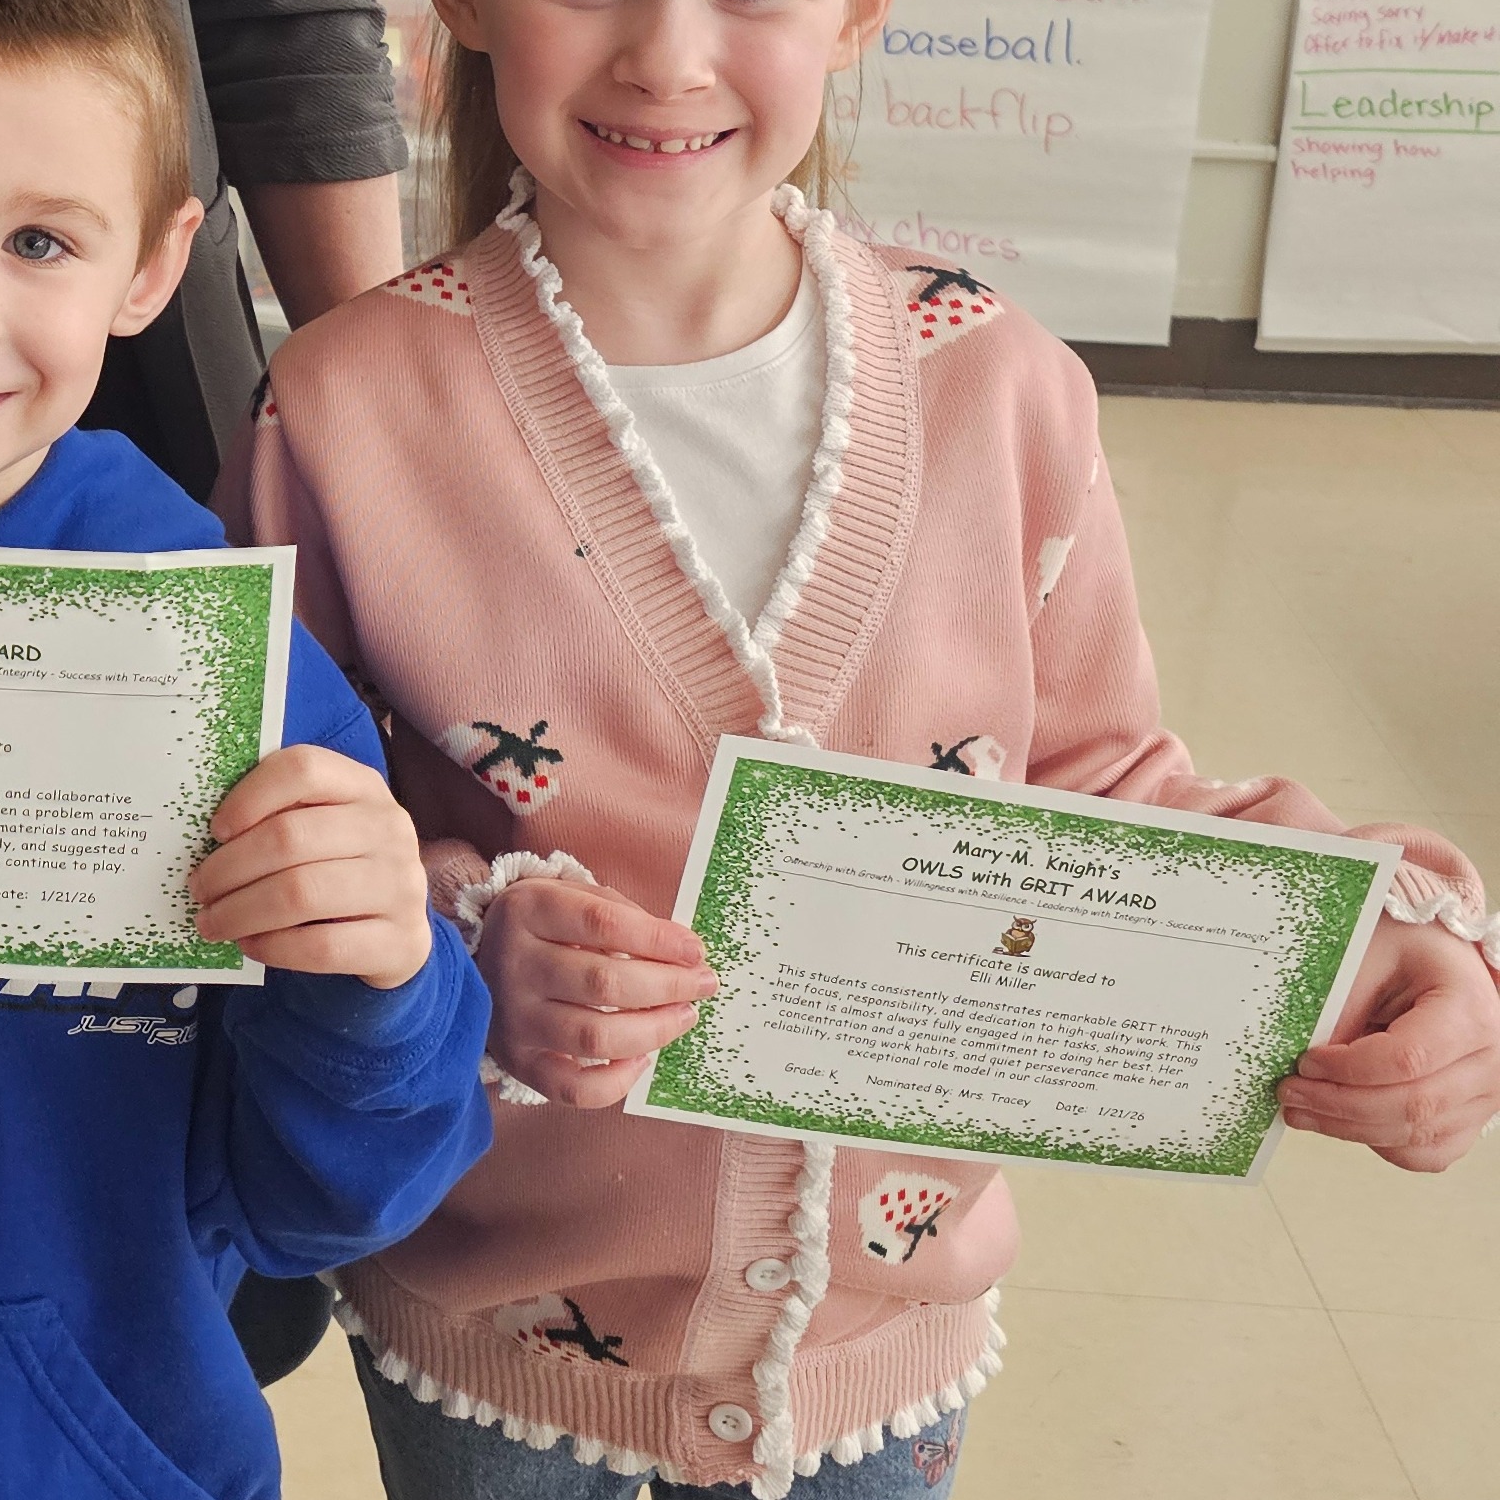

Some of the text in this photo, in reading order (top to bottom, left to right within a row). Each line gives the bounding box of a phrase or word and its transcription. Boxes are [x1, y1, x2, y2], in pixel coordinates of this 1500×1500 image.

[1300, 79, 1494, 132] Leadership
[1291, 160, 1376, 187] helping
[69, 824, 97, 837] and
[101, 825, 147, 842] taking
[951, 838, 1121, 881] Mary M. Knight's
[900, 855, 1157, 911] OWLS with GRIT AWARD
[968, 969, 1037, 991] Elli Miller
[846, 1048, 1098, 1091] exceptional role model in our classroom.
